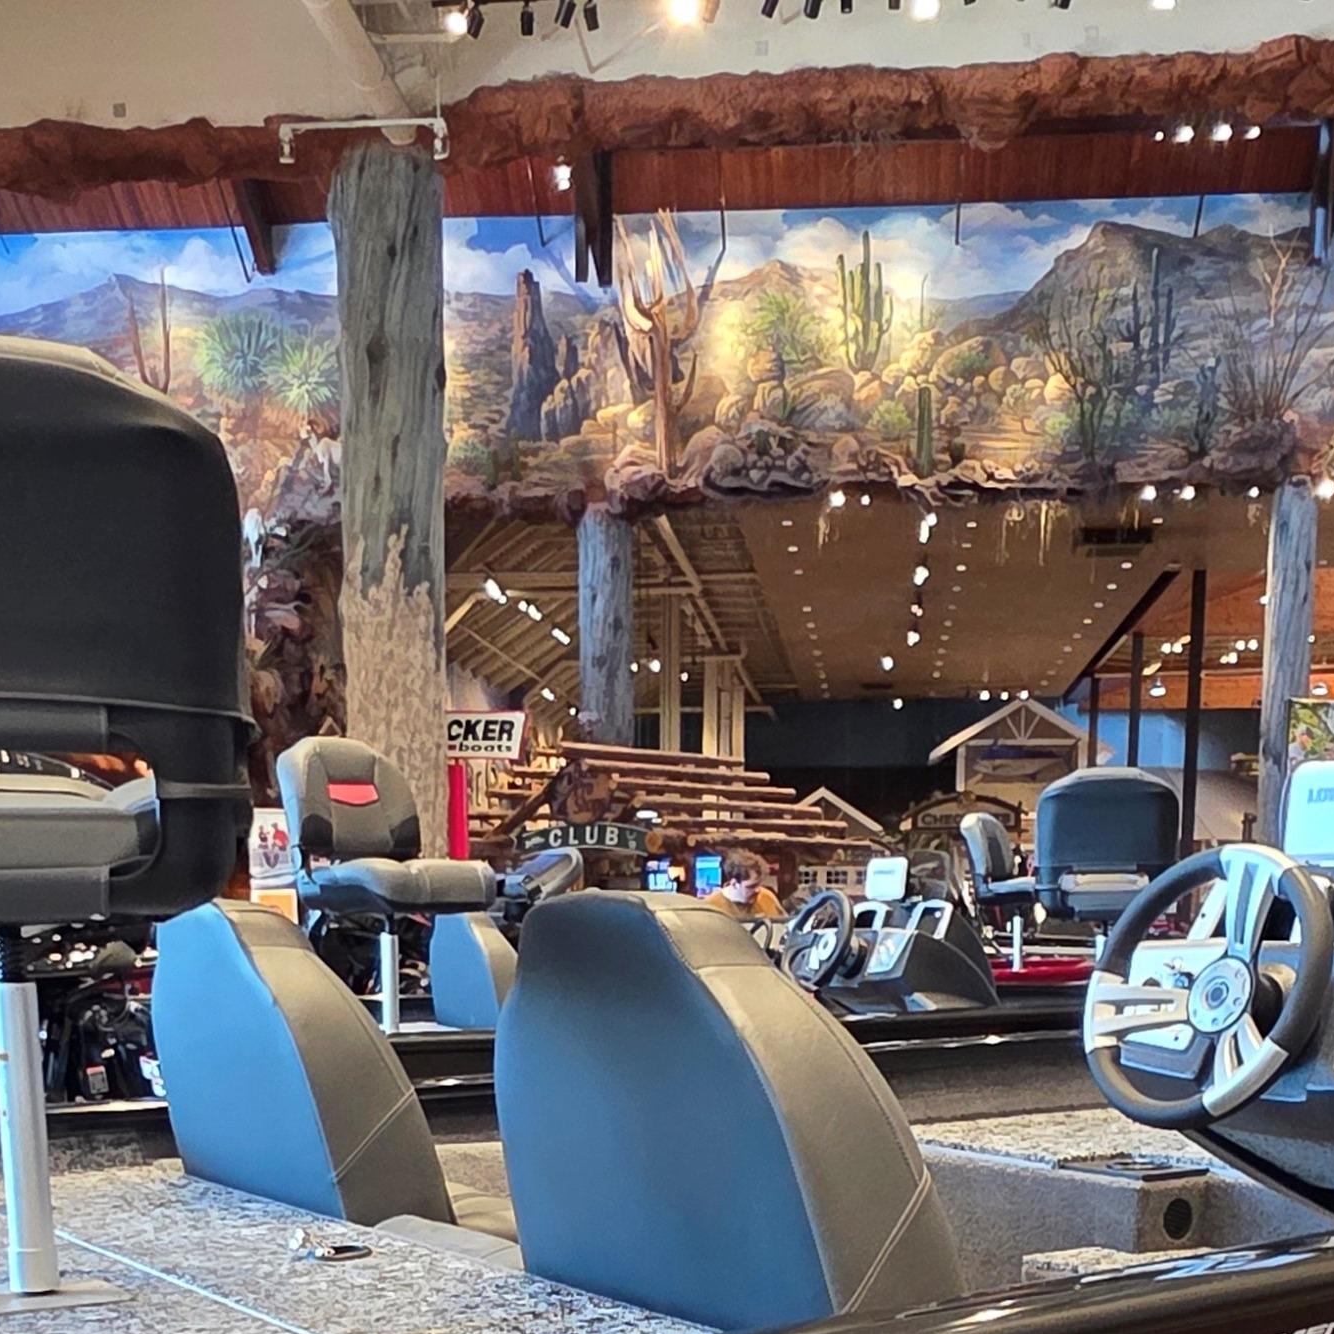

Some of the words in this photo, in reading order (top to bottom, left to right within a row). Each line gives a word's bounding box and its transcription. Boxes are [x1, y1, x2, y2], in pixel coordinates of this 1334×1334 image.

[448, 719, 515, 742] CKER
[458, 742, 513, 753] boats
[548, 825, 620, 848] CLUB
